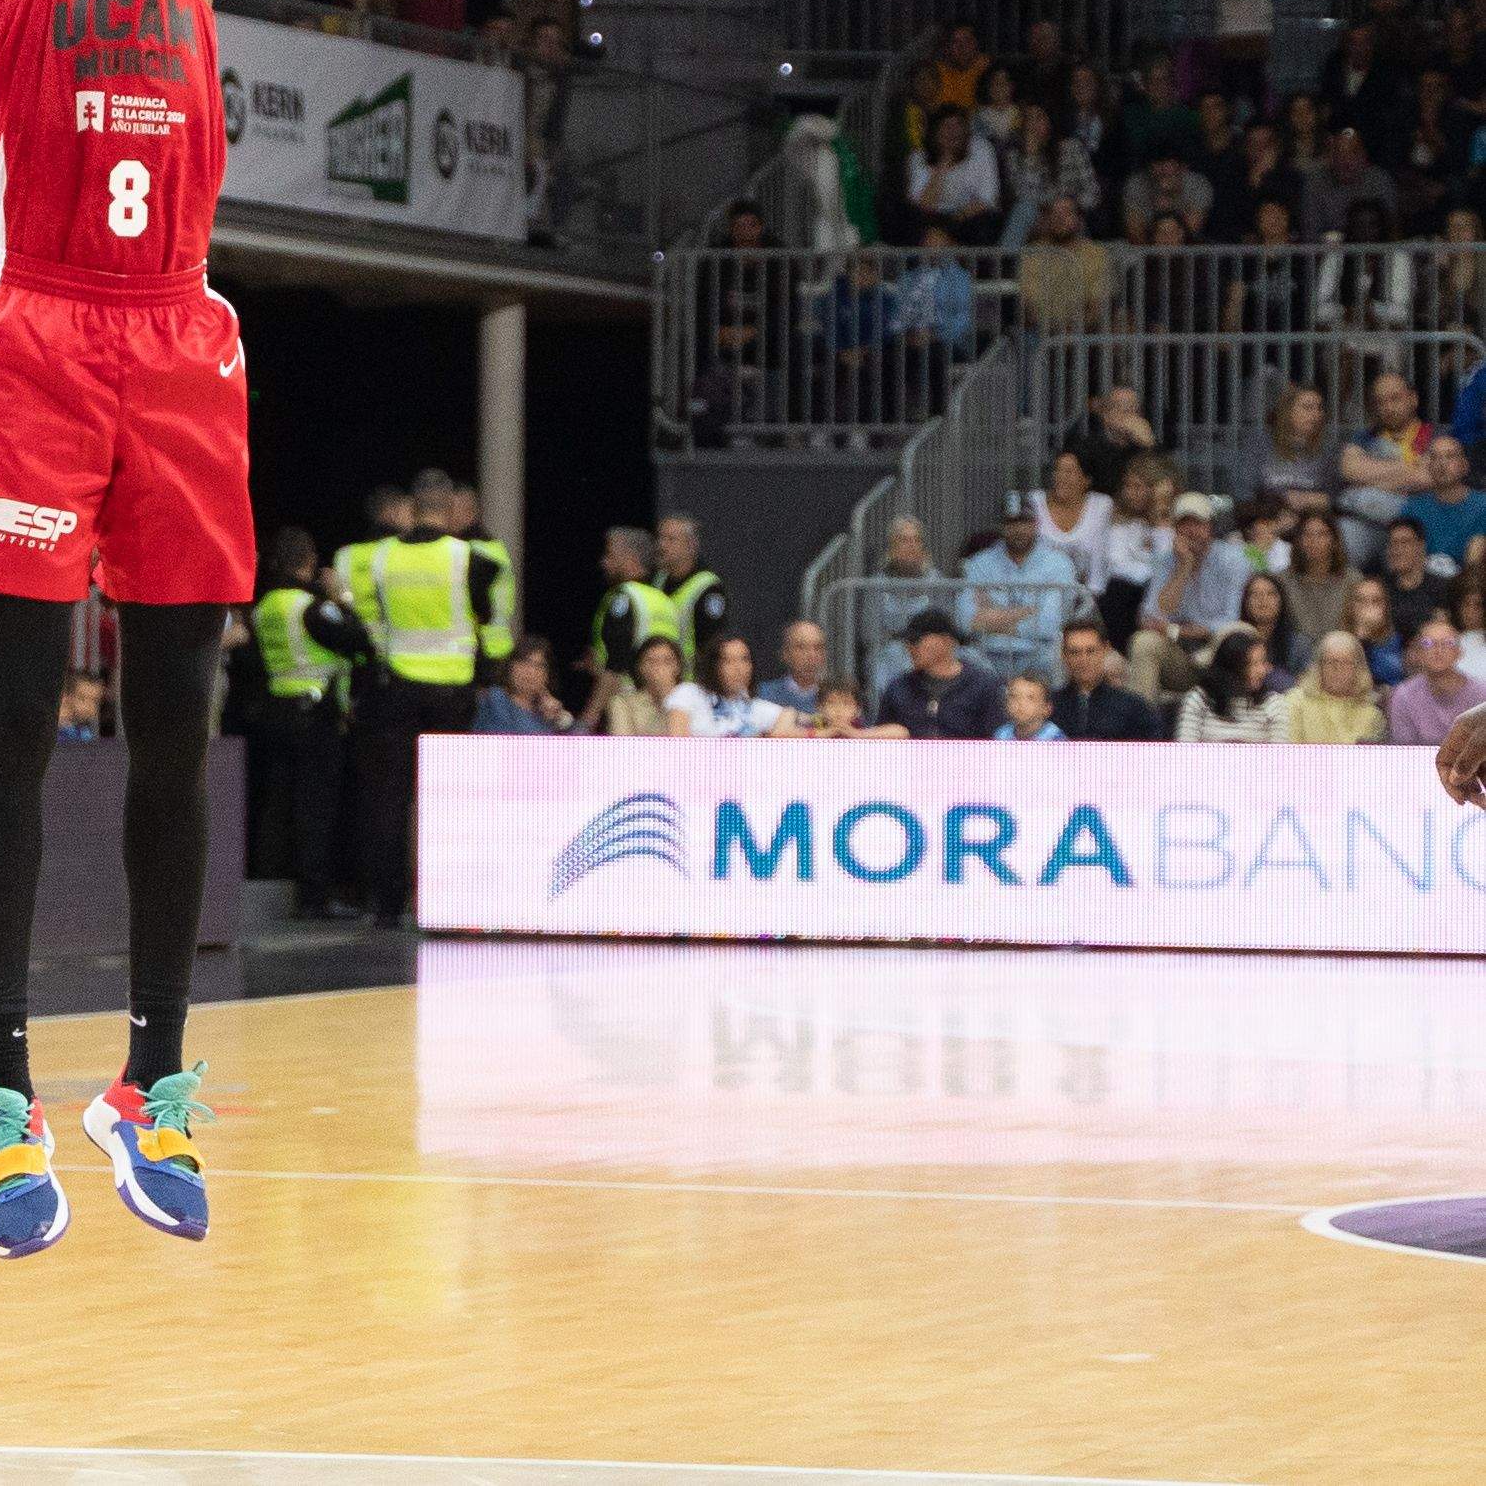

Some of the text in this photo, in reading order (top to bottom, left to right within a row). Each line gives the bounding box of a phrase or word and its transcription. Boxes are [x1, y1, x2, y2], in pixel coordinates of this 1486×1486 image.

[75, 47, 189, 88] MURCIA
[111, 94, 168, 109] CARAVACA
[111, 107, 124, 119] DE
[126, 109, 137, 120] LA
[138, 110, 165, 122] CRUZ
[108, 159, 150, 237] 8
